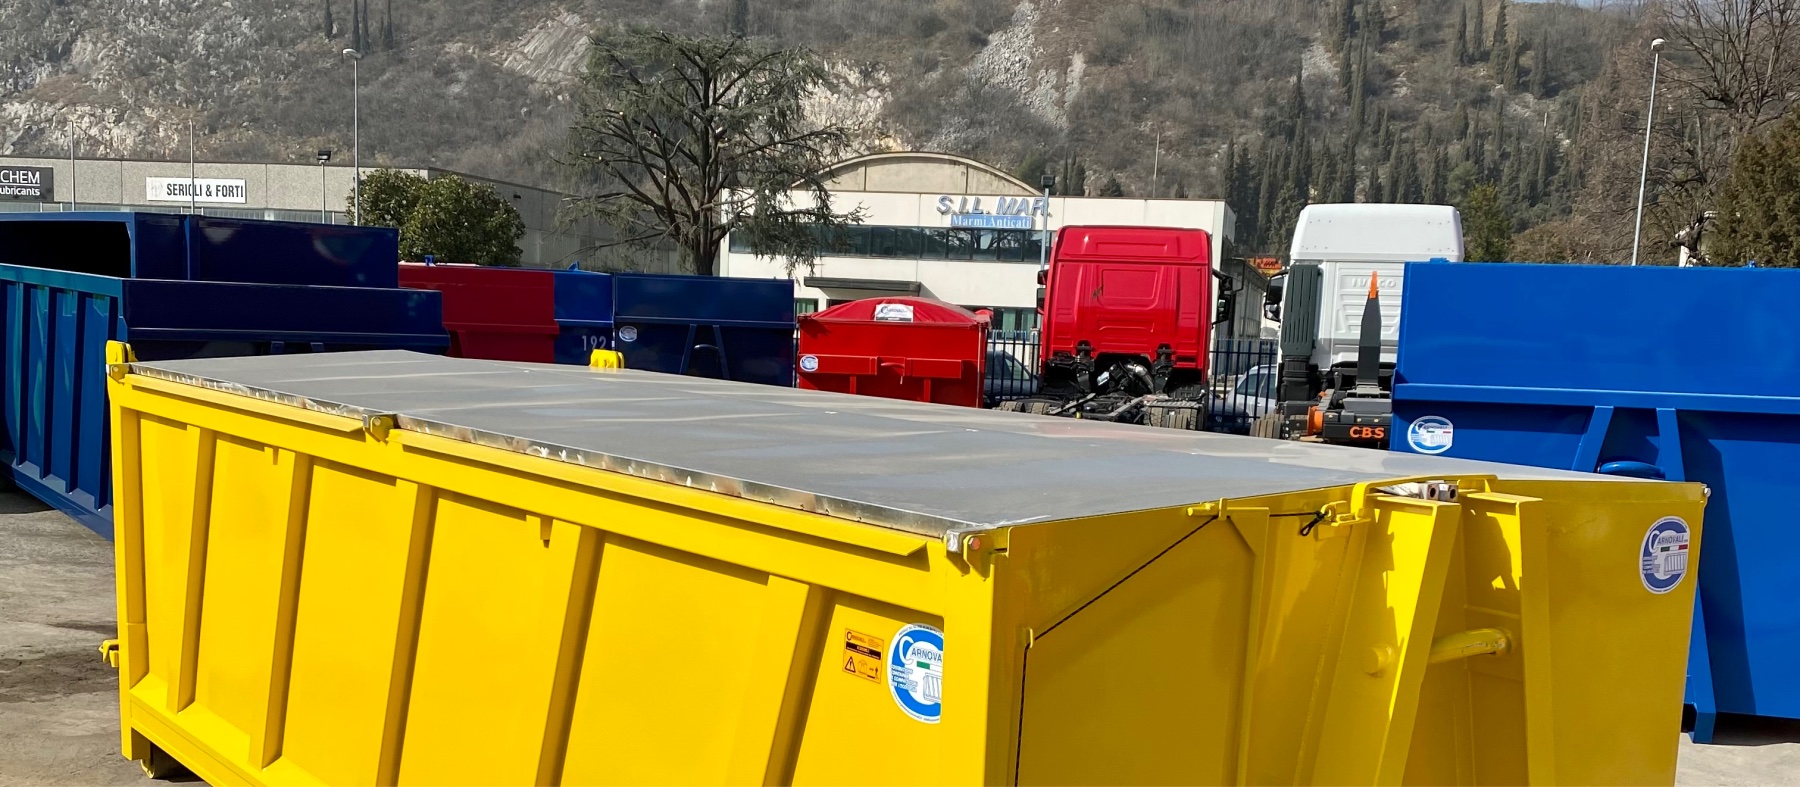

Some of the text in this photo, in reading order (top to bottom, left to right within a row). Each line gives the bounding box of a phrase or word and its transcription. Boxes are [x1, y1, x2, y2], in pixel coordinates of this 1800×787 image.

[0, 170, 40, 184] CHEM
[205, 184, 212, 197] &
[215, 185, 243, 198] FORTI
[952, 215, 987, 226] Marmi
[1352, 278, 1396, 288] IVCO
[582, 335, 606, 350] 192
[1350, 426, 1385, 438] CBS
